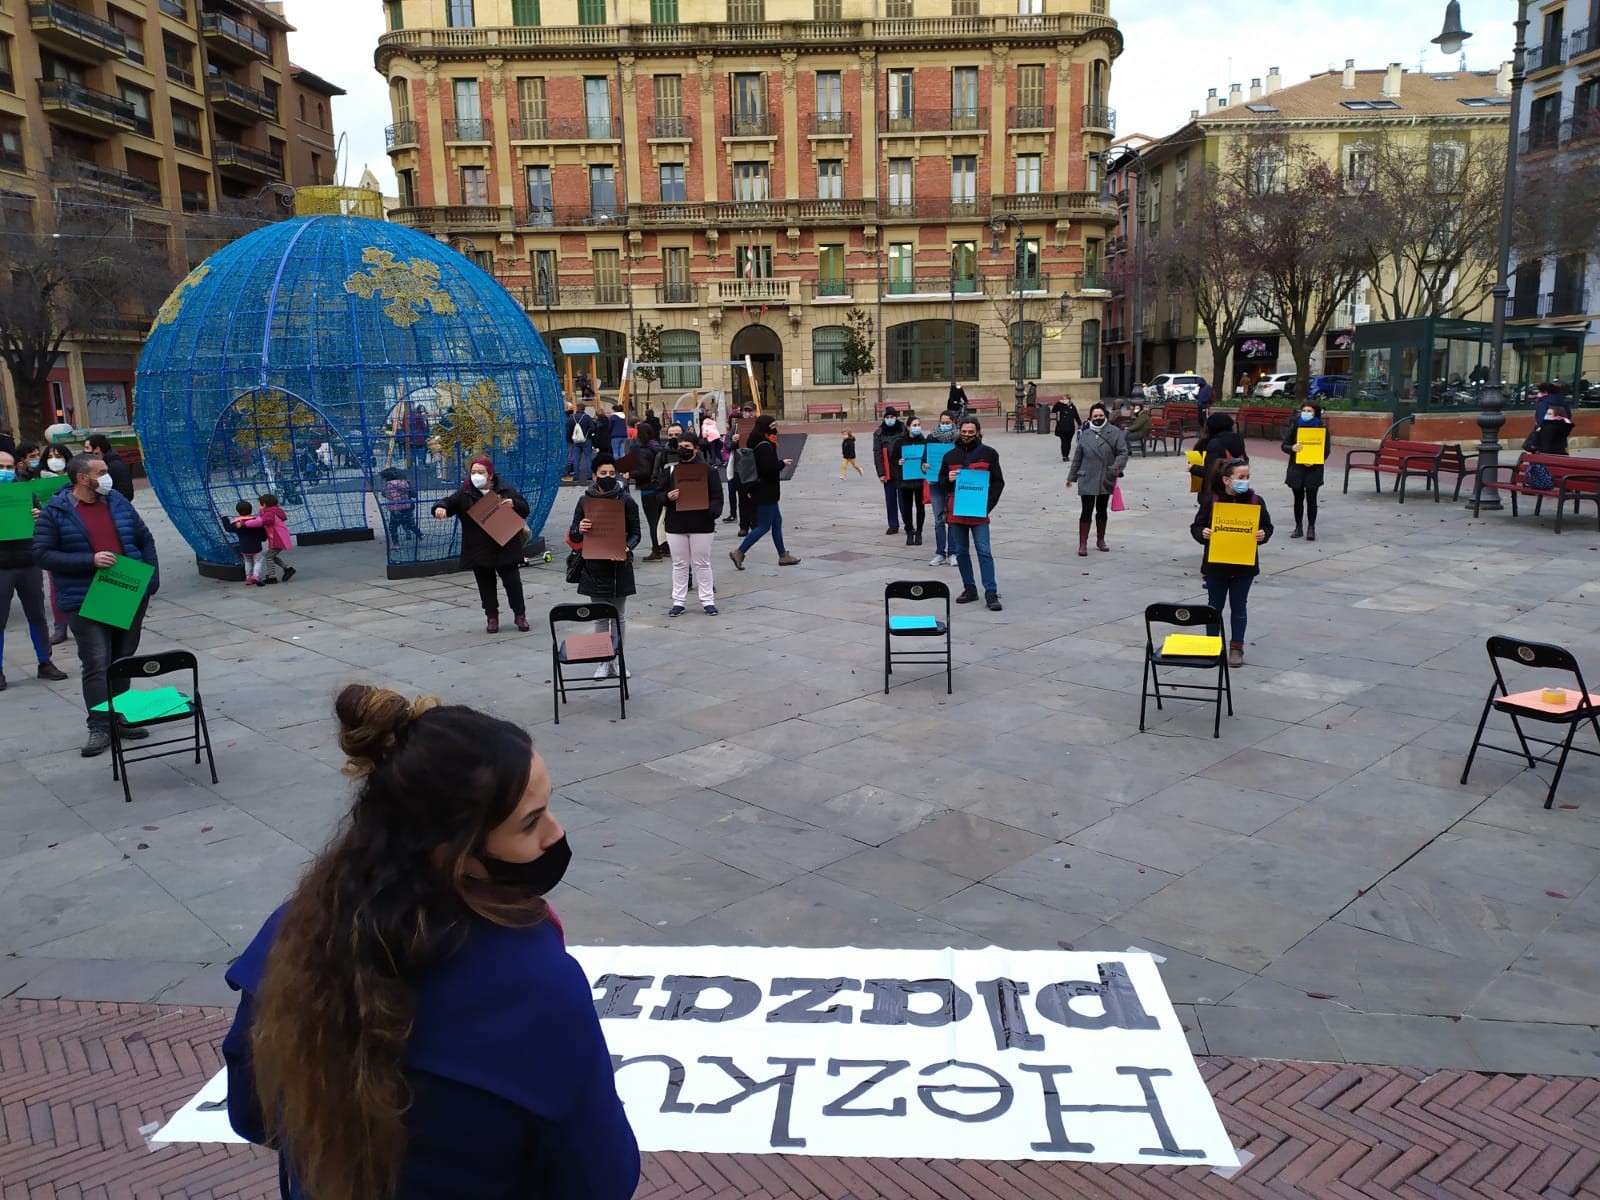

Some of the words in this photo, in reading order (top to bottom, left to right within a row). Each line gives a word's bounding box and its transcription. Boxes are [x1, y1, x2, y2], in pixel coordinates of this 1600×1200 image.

[1214, 525, 1253, 533] plazara!
[1215, 516, 1254, 526] Ikasleak
[97, 575, 140, 593] plazara!
[592, 962, 1161, 1051] plazar
[609, 1053, 1207, 1159] Hezku
